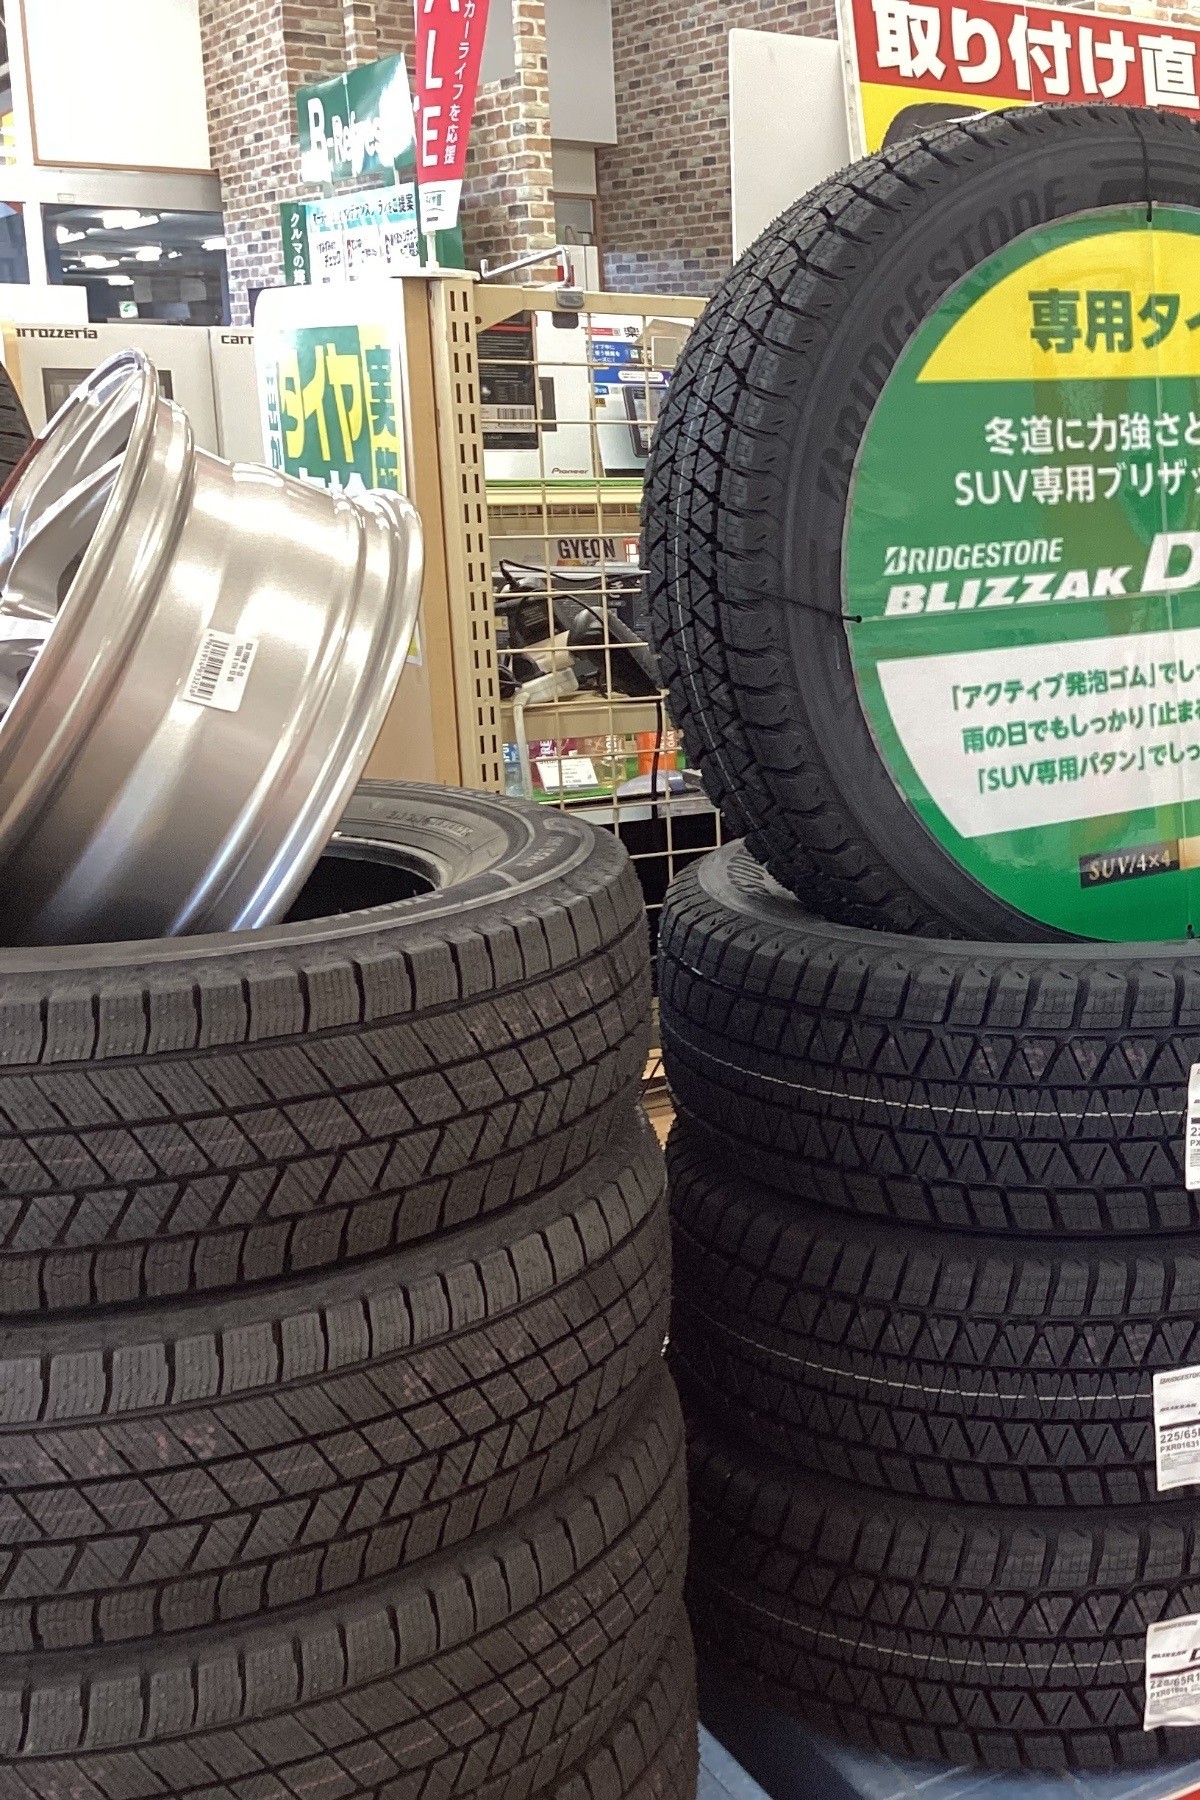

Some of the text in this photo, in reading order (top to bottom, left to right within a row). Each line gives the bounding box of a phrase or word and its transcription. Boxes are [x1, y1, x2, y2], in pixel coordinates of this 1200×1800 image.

[279, 342, 362, 464] タイヤ
[551, 467, 589, 475] Pioneer
[557, 538, 616, 559] GYEON
[884, 537, 1064, 576] BRIDGESTONE
[884, 565, 1133, 616] BLIZZAK
